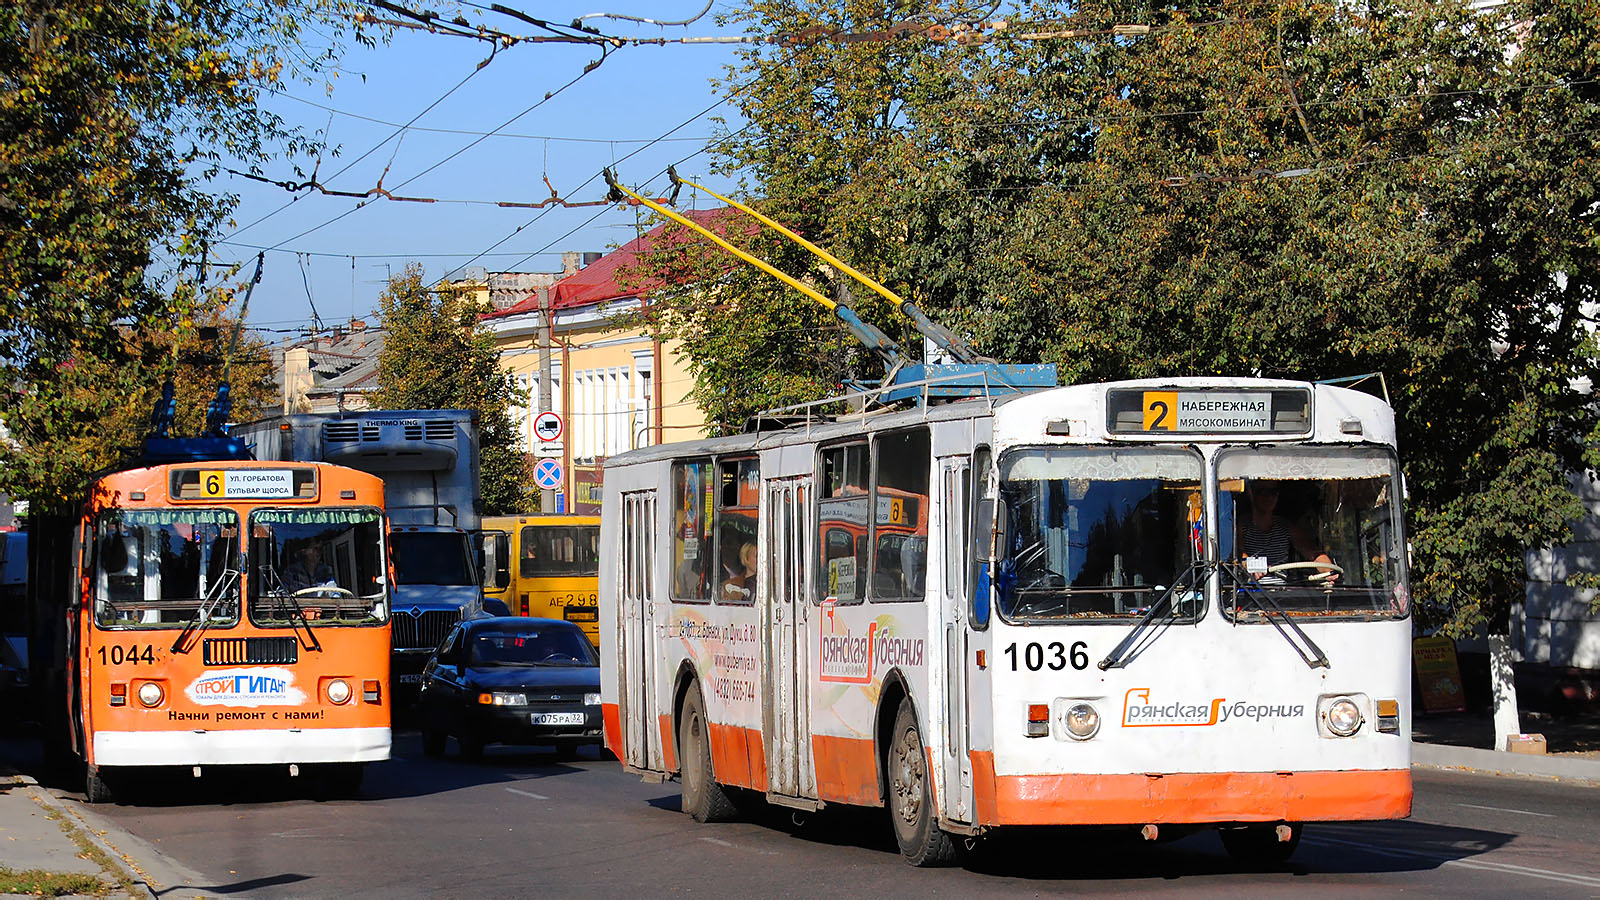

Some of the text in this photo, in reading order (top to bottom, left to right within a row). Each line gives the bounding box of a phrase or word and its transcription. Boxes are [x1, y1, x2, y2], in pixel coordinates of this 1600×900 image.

[1181, 401, 1265, 412] НАБЕРЕЖНАЯ
[1149, 401, 1169, 431] 2
[1179, 418, 1267, 428] МЯСОКОМБИНАТ
[207, 474, 219, 495] 6
[227, 486, 289, 495] БУЛЬВАР ЩОРСА
[98, 644, 155, 665] 1044
[1004, 641, 1089, 671] 1036
[168, 709, 324, 722] Начни ремонт с нами!
